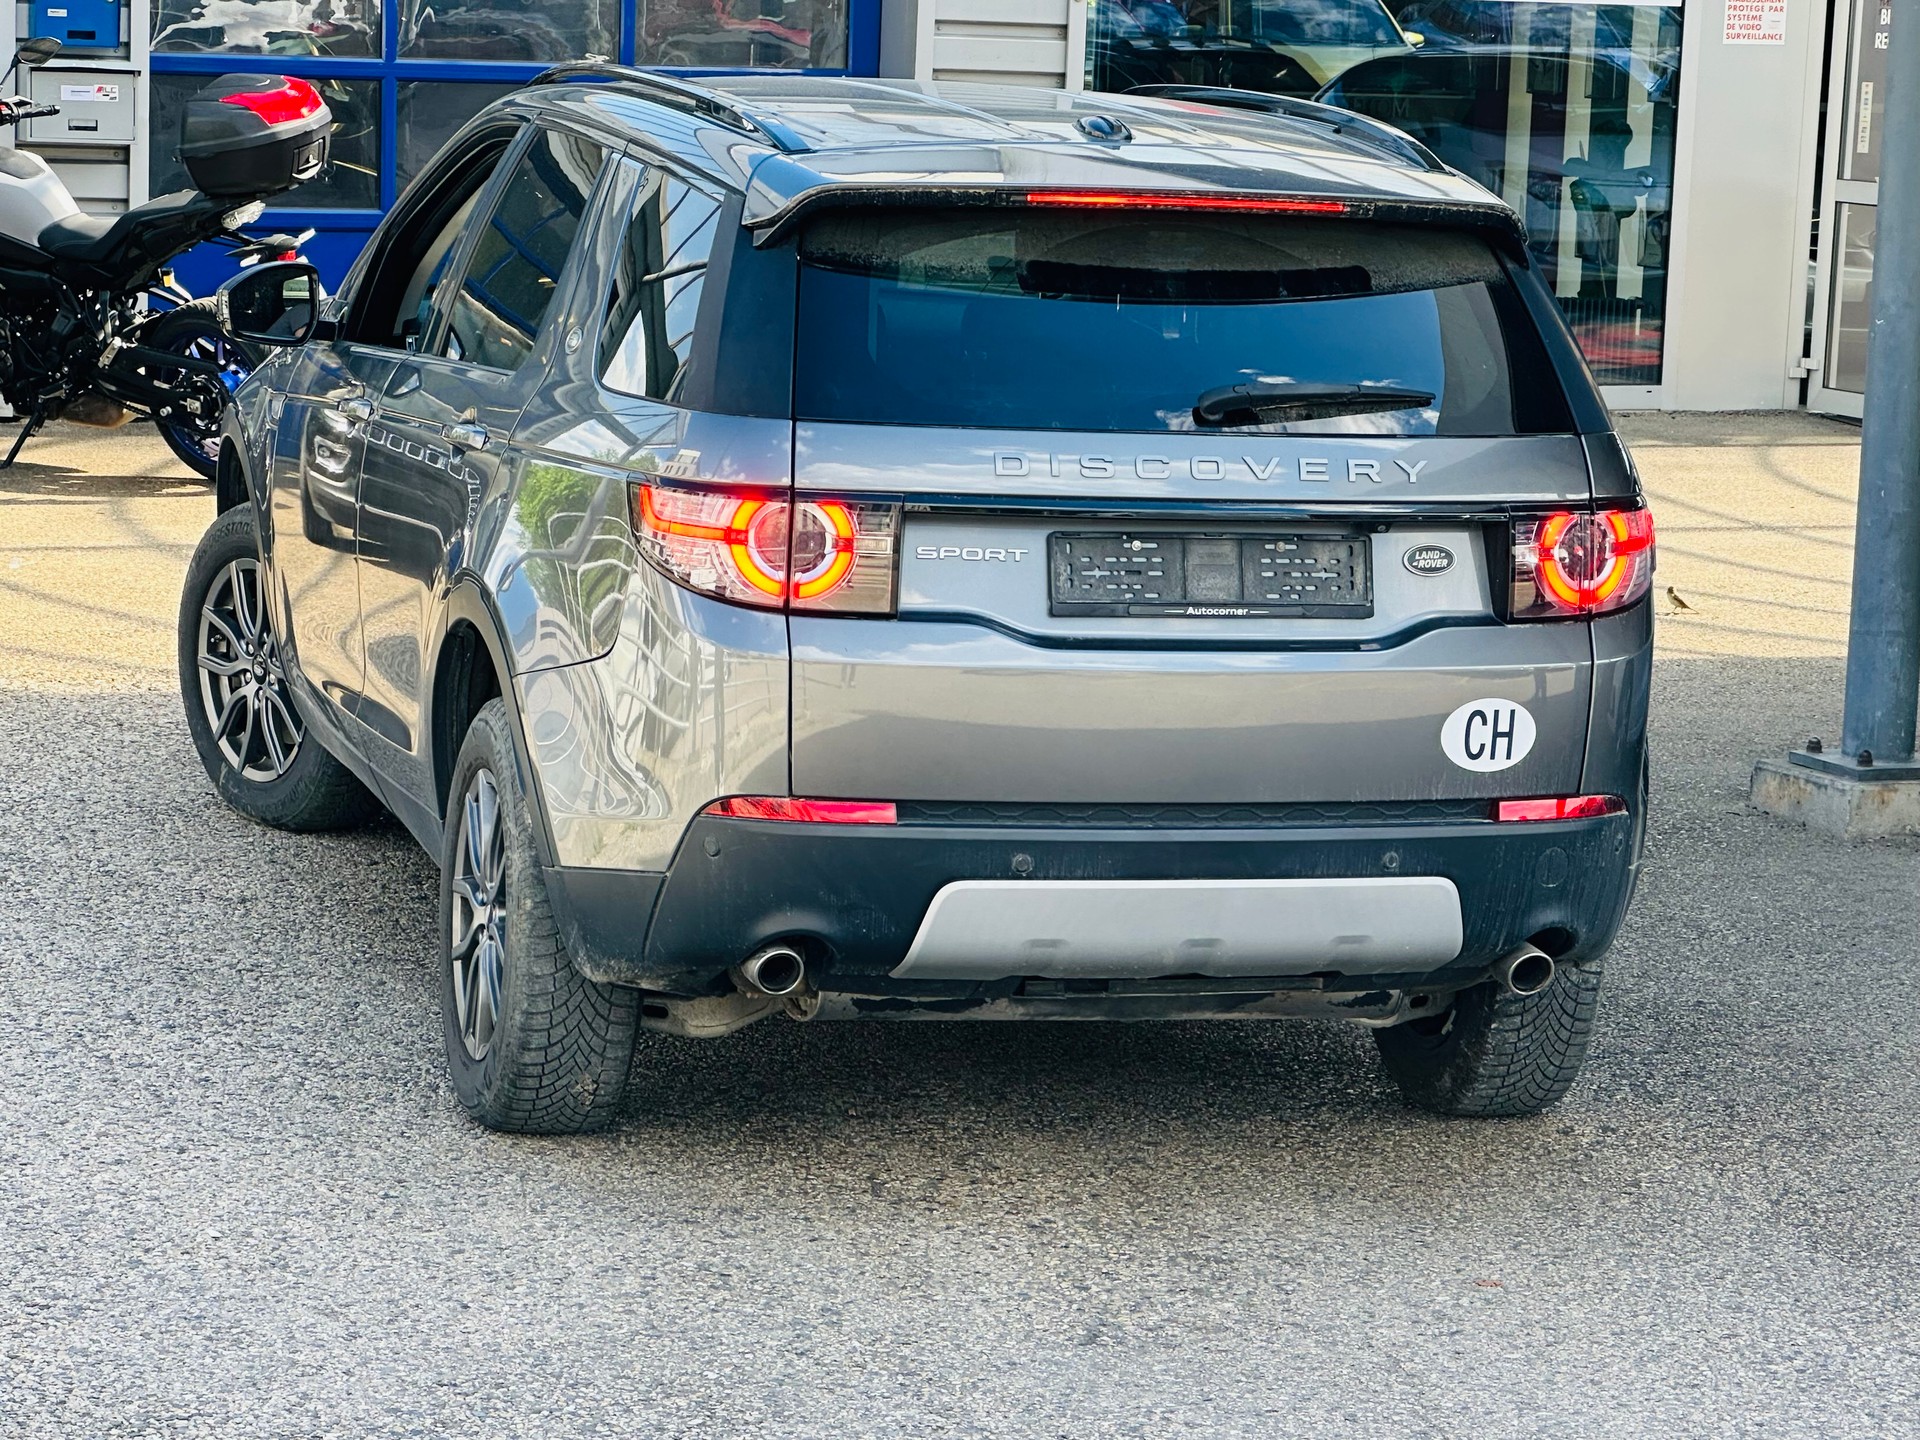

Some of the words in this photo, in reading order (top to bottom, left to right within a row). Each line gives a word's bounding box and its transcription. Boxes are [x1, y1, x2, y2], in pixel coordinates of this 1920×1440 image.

[1726, 32, 1783, 41] SURVEILLANCE
[994, 451, 1428, 484] DISCOVERY
[916, 546, 1029, 562] SPORT
[1415, 550, 1440, 560] LAND
[1418, 558, 1449, 568] ROVER
[1186, 606, 1249, 616] Autocorner
[1464, 708, 1516, 761] CH
